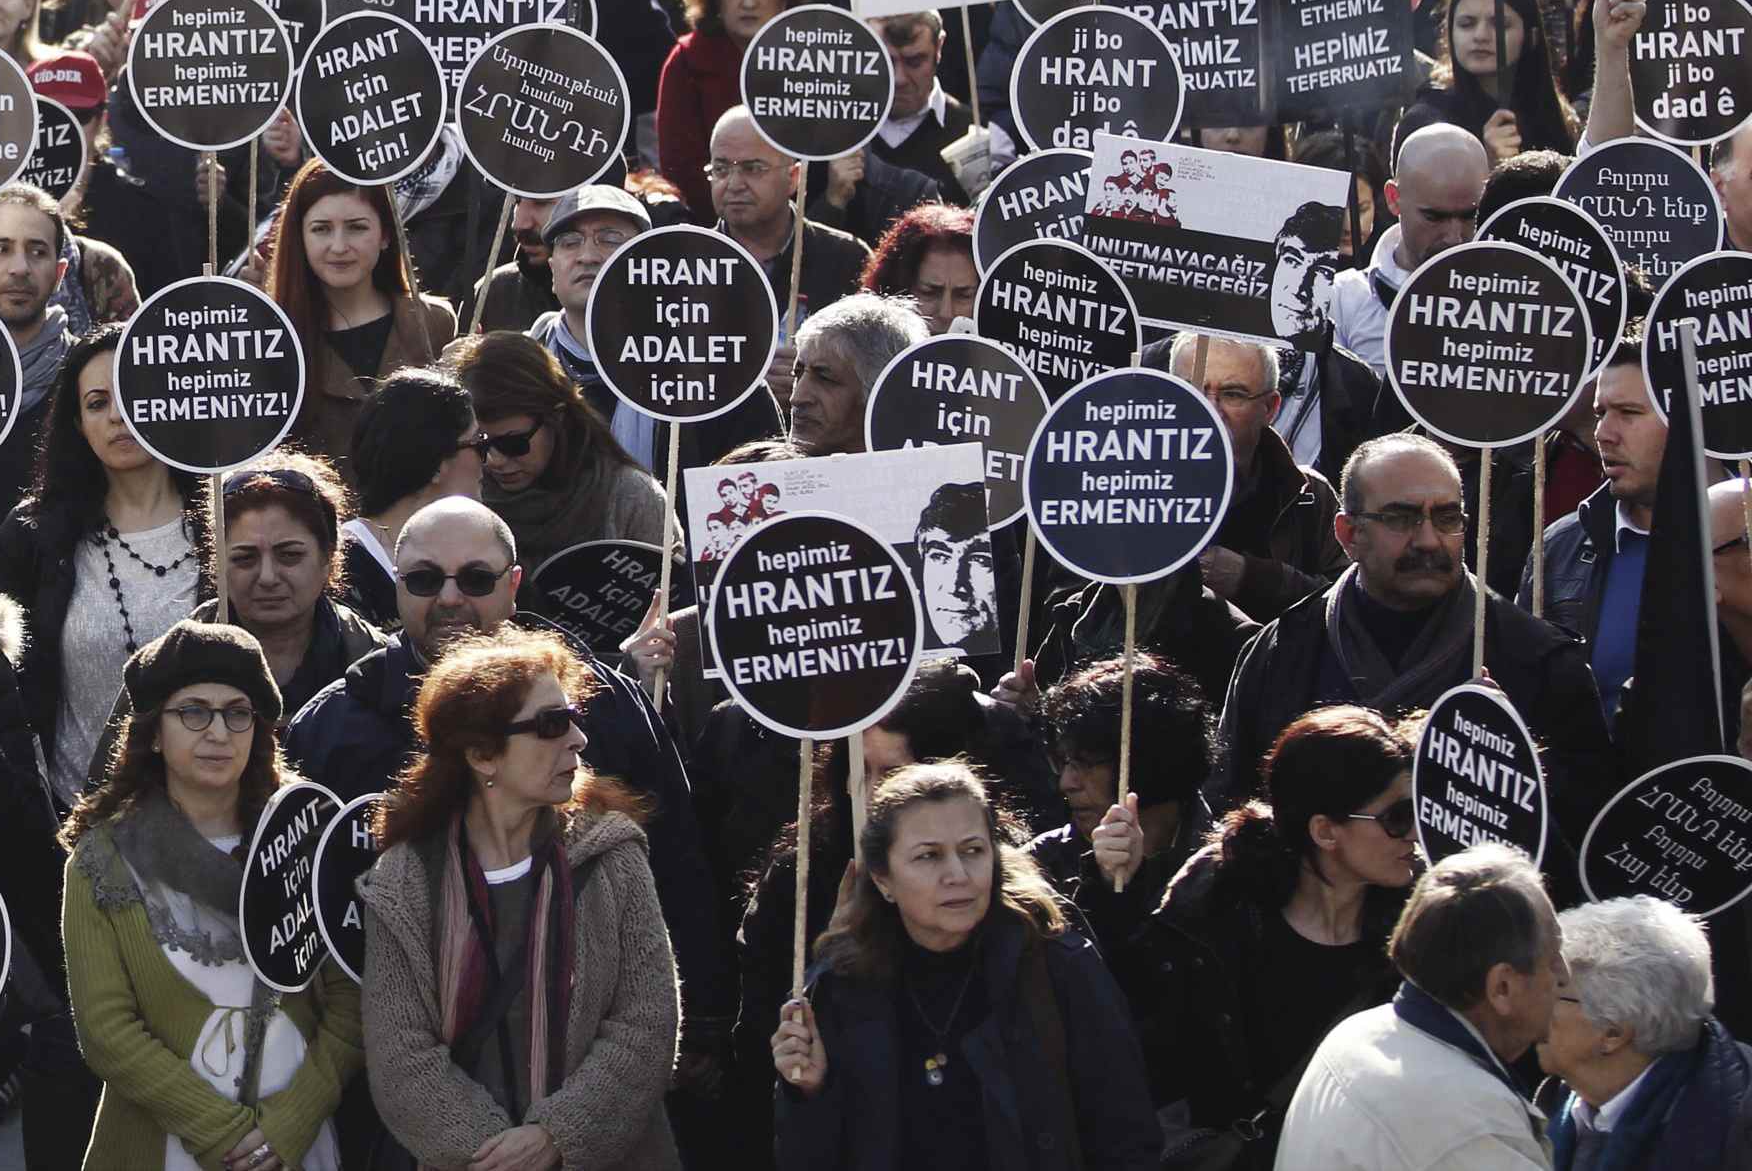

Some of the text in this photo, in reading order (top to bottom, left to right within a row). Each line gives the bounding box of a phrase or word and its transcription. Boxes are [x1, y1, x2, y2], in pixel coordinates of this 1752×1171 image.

[173, 7, 245, 29] hepimiz
[1664, 3, 1710, 28] ji bo
[144, 28, 276, 58] HRANTIZ
[1636, 28, 1745, 60] HRANT
[175, 61, 247, 83] hepimiz
[1286, 53, 1402, 93] TEFERRUATIZ
[1667, 63, 1714, 88] ji bo
[1653, 87, 1734, 119] dad ê
[1082, 233, 1267, 279] UNUTMAYACAĞIZ
[628, 258, 739, 285] HRANT
[1449, 269, 1540, 296] hepimiz
[656, 296, 709, 328] için
[1409, 294, 1575, 337] HRANTIZ
[619, 336, 746, 363] ADALET
[1443, 336, 1534, 363] hepimiz
[651, 374, 715, 405] için!
[1085, 399, 1176, 425] hepimiz
[1047, 428, 1213, 462] HRANTIZ
[1082, 469, 1173, 496] hepimiz
[757, 541, 851, 573] hepimiz
[725, 565, 896, 622] HRANTIZ
[767, 614, 863, 649] hepimiz
